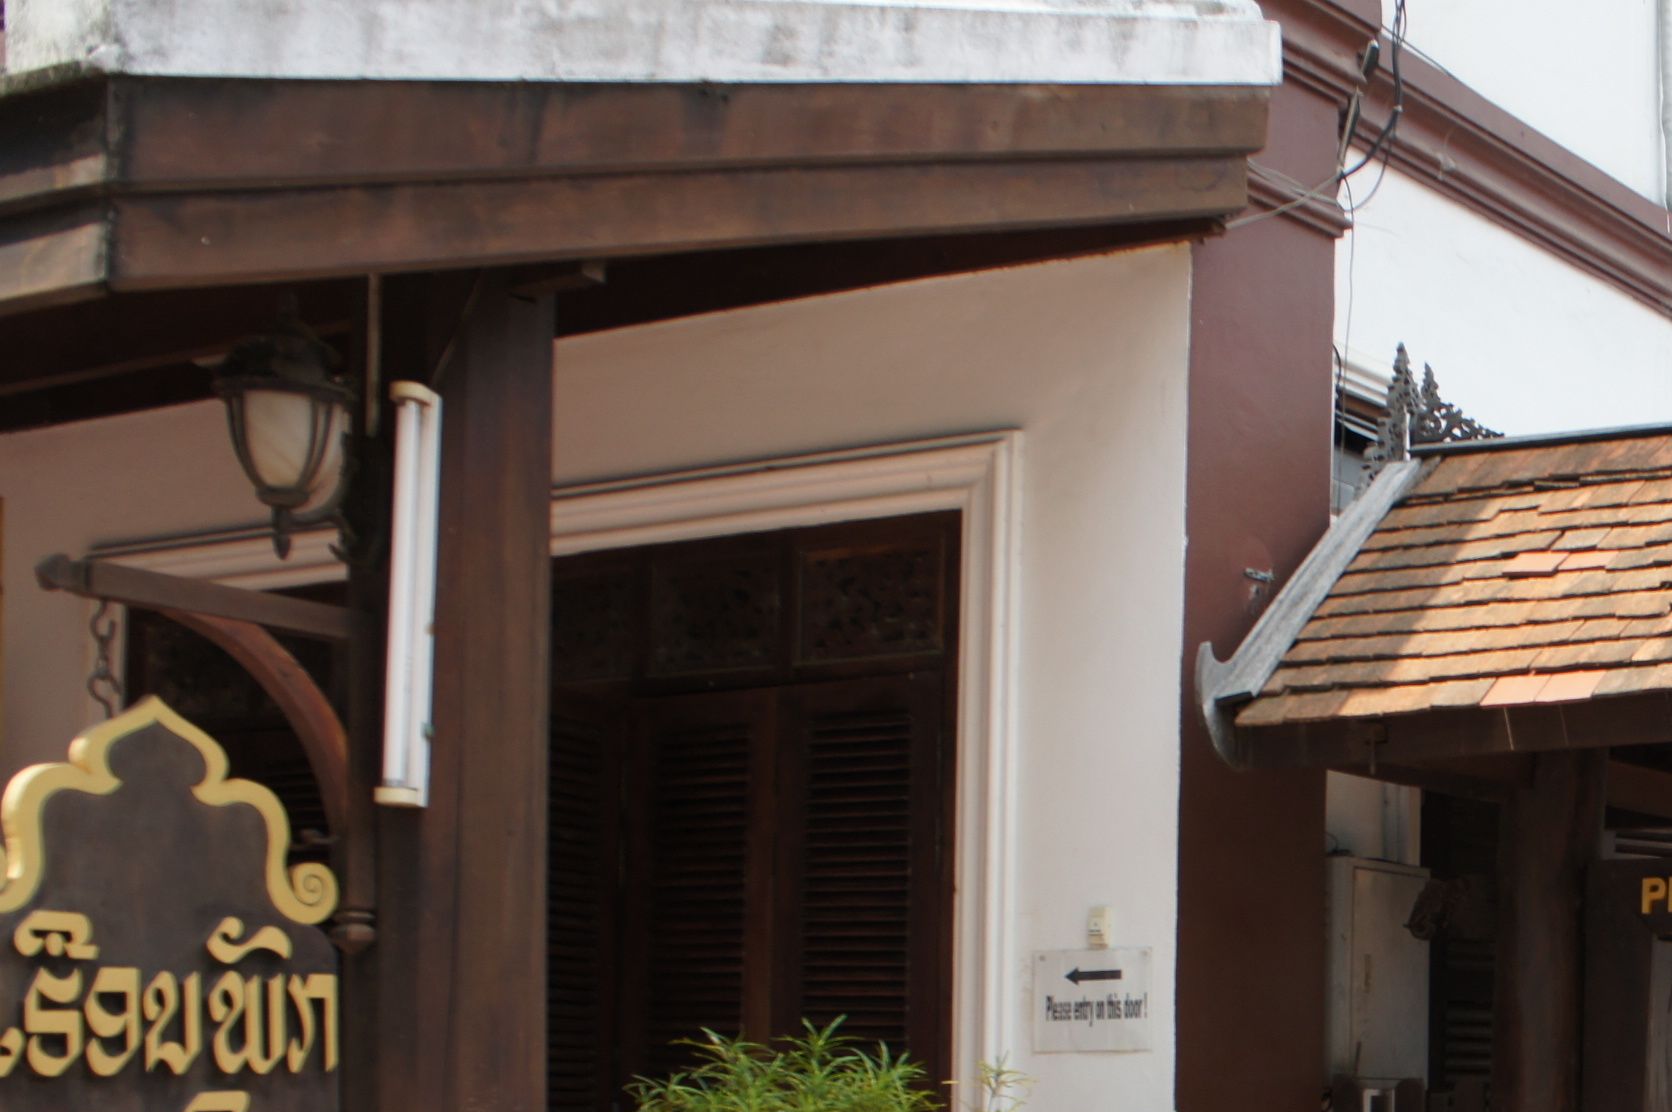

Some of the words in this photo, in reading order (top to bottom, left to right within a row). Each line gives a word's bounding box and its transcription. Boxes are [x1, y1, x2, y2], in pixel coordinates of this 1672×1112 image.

[1046, 995, 1072, 1021] Please
[1074, 995, 1094, 1027] entry
[1096, 1000, 1104, 1019] on
[1106, 993, 1121, 1019] this
[1124, 994, 1142, 1019] door
